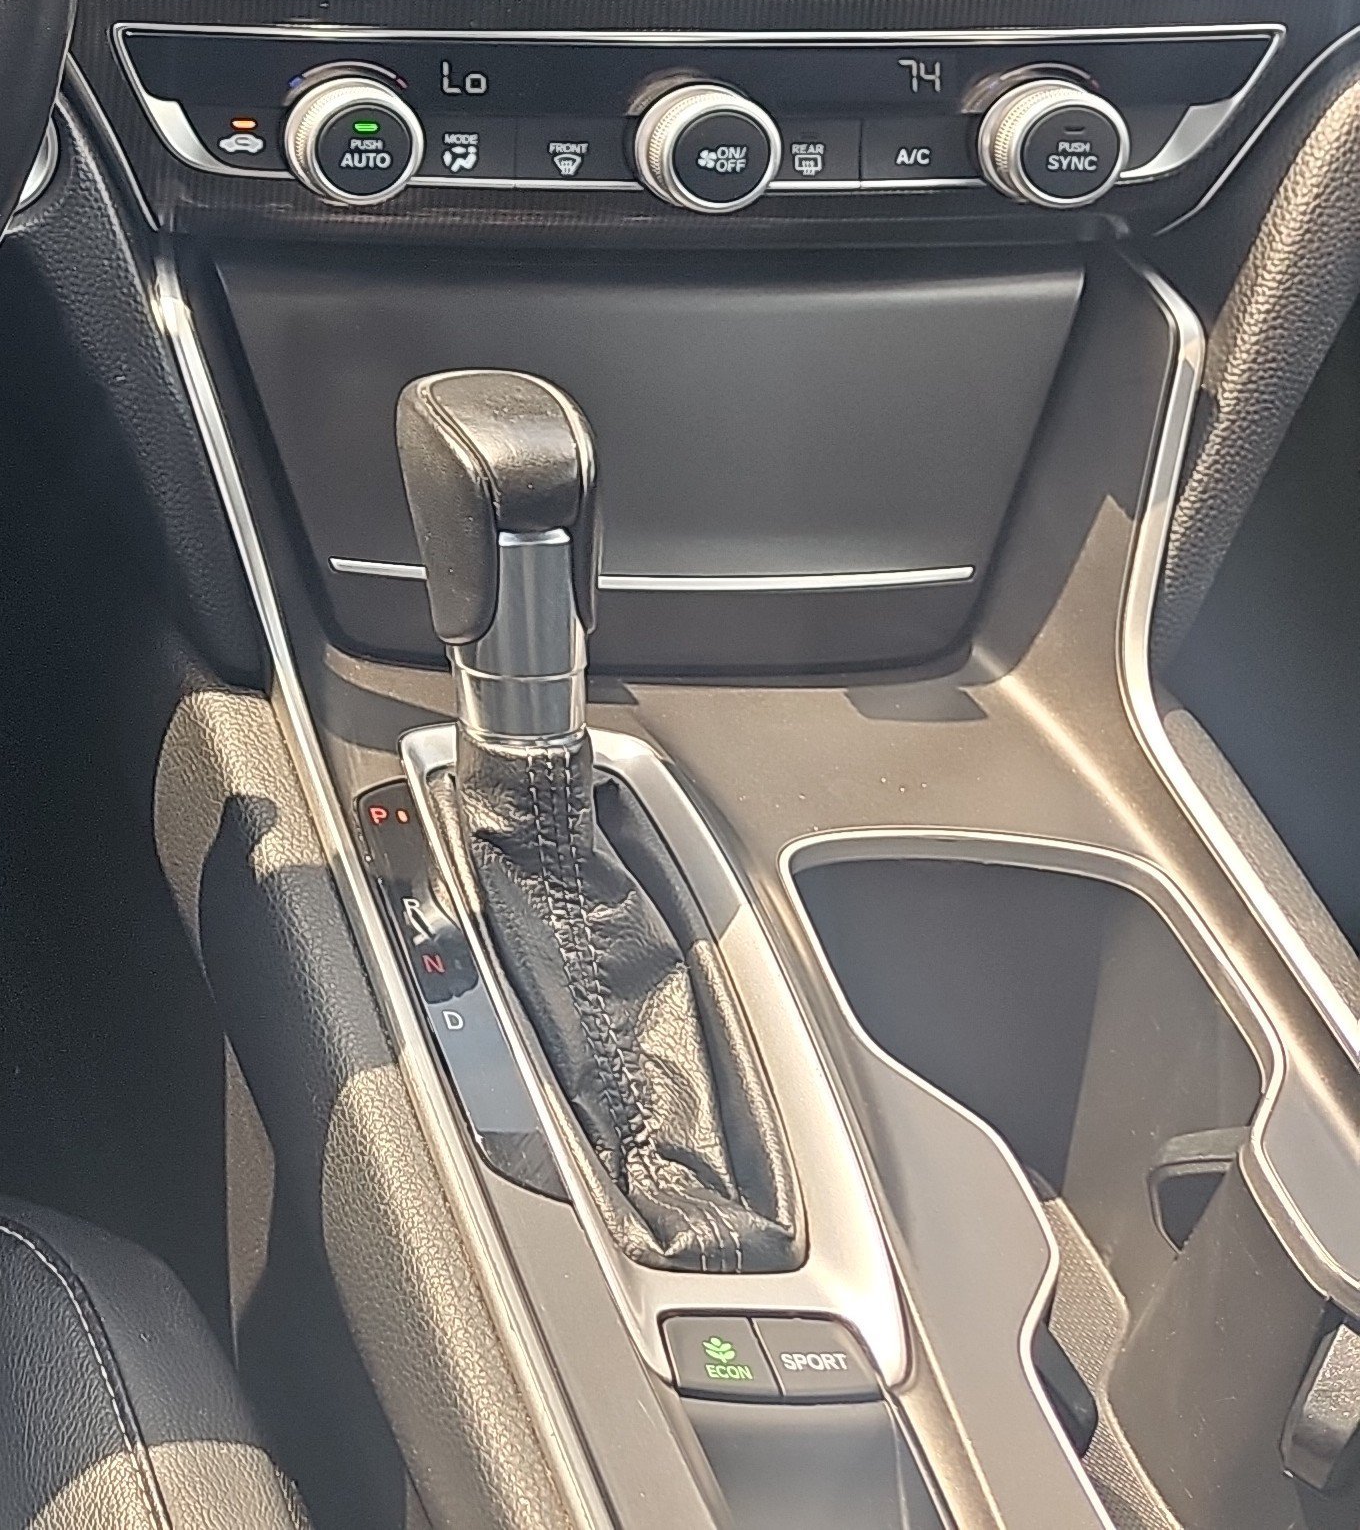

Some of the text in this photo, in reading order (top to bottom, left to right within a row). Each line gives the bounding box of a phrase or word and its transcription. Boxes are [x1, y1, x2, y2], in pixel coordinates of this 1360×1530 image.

[441, 61, 488, 95] Lo
[898, 59, 942, 93] 74
[350, 139, 382, 151] PUSH
[444, 134, 478, 145] MODE
[1058, 141, 1090, 153] PUSH
[549, 143, 588, 155] FRONT
[717, 146, 747, 160] ON/
[791, 144, 824, 155] REAR
[896, 148, 930, 167] A/C
[340, 152, 391, 170] AUTO
[716, 159, 746, 173] OFF
[1047, 154, 1098, 172] SYNC
[369, 807, 387, 824] P
[422, 954, 445, 973] N
[442, 1010, 464, 1030] D
[780, 1353, 848, 1371] SPORT
[705, 1364, 753, 1381] ECON
